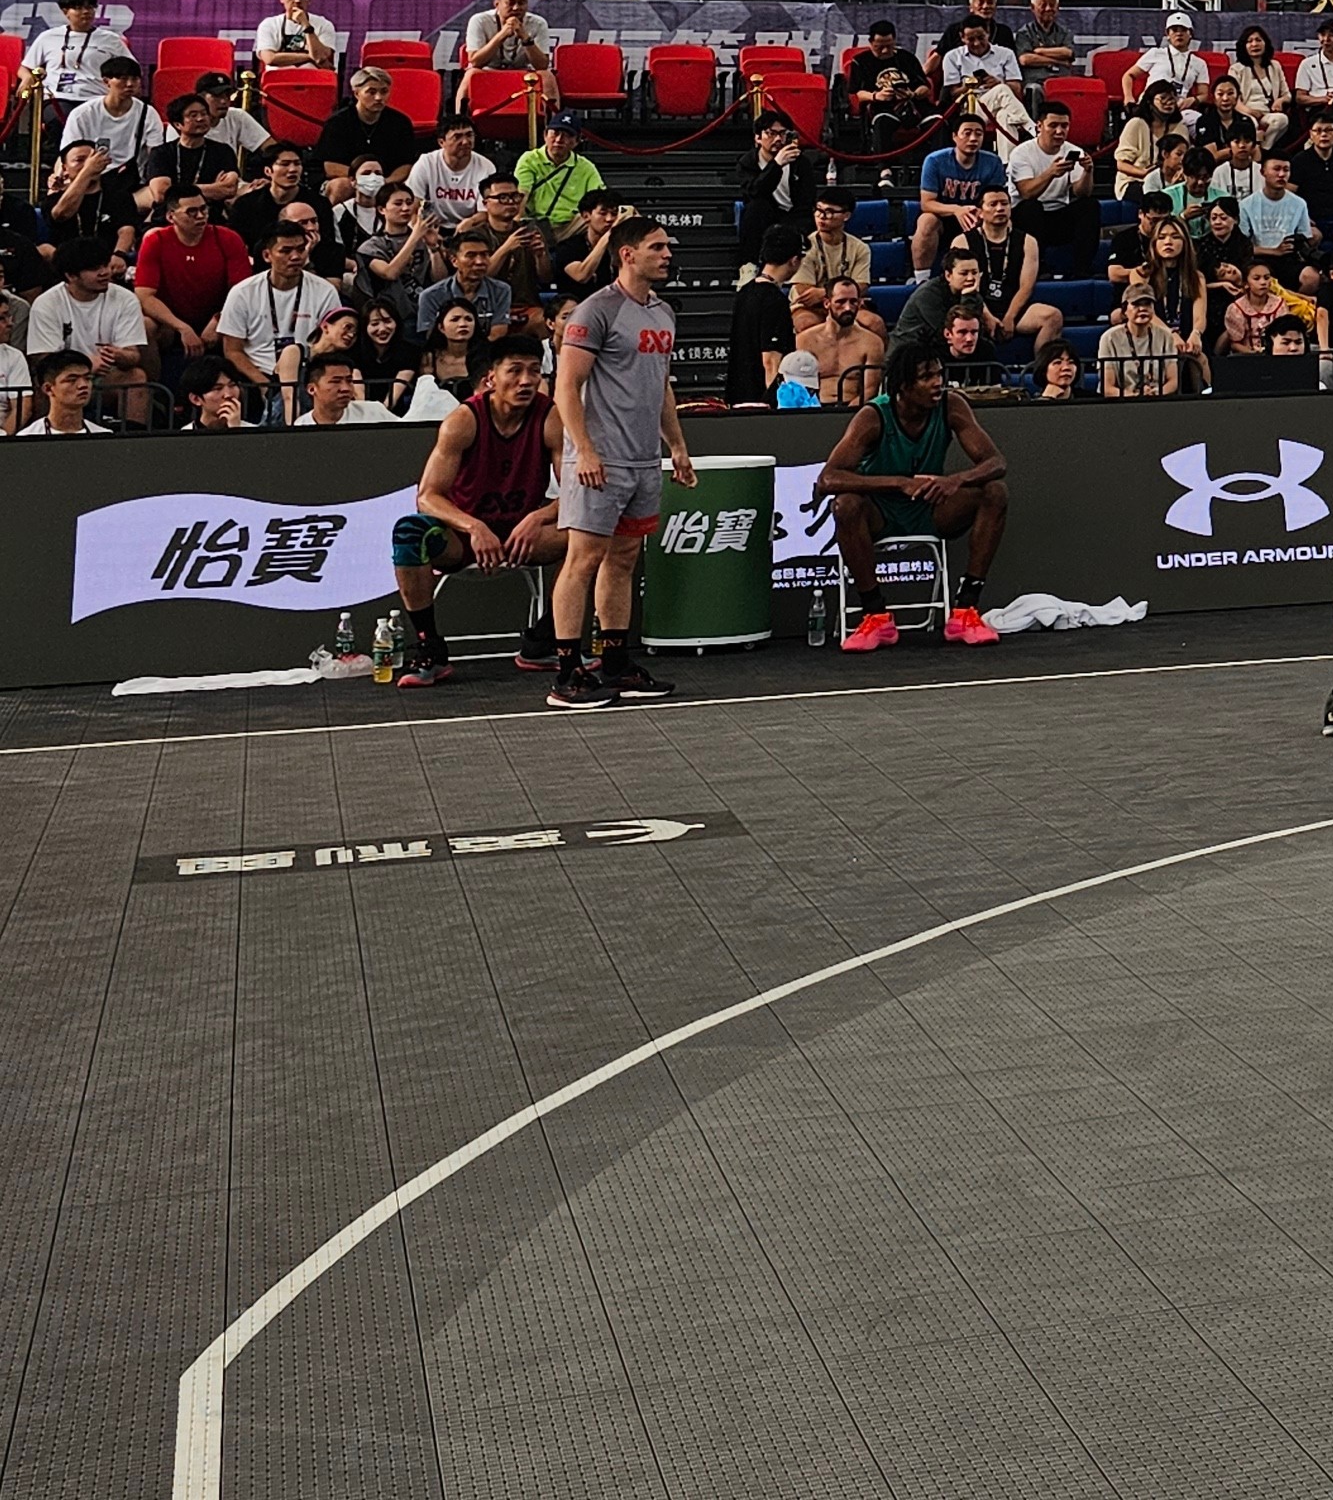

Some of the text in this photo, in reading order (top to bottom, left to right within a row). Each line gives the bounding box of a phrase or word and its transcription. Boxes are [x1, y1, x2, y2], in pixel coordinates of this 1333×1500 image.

[435, 186, 476, 201] CHINA
[688, 348, 730, 360] 领先体
[1156, 551, 1238, 569] UNDER
